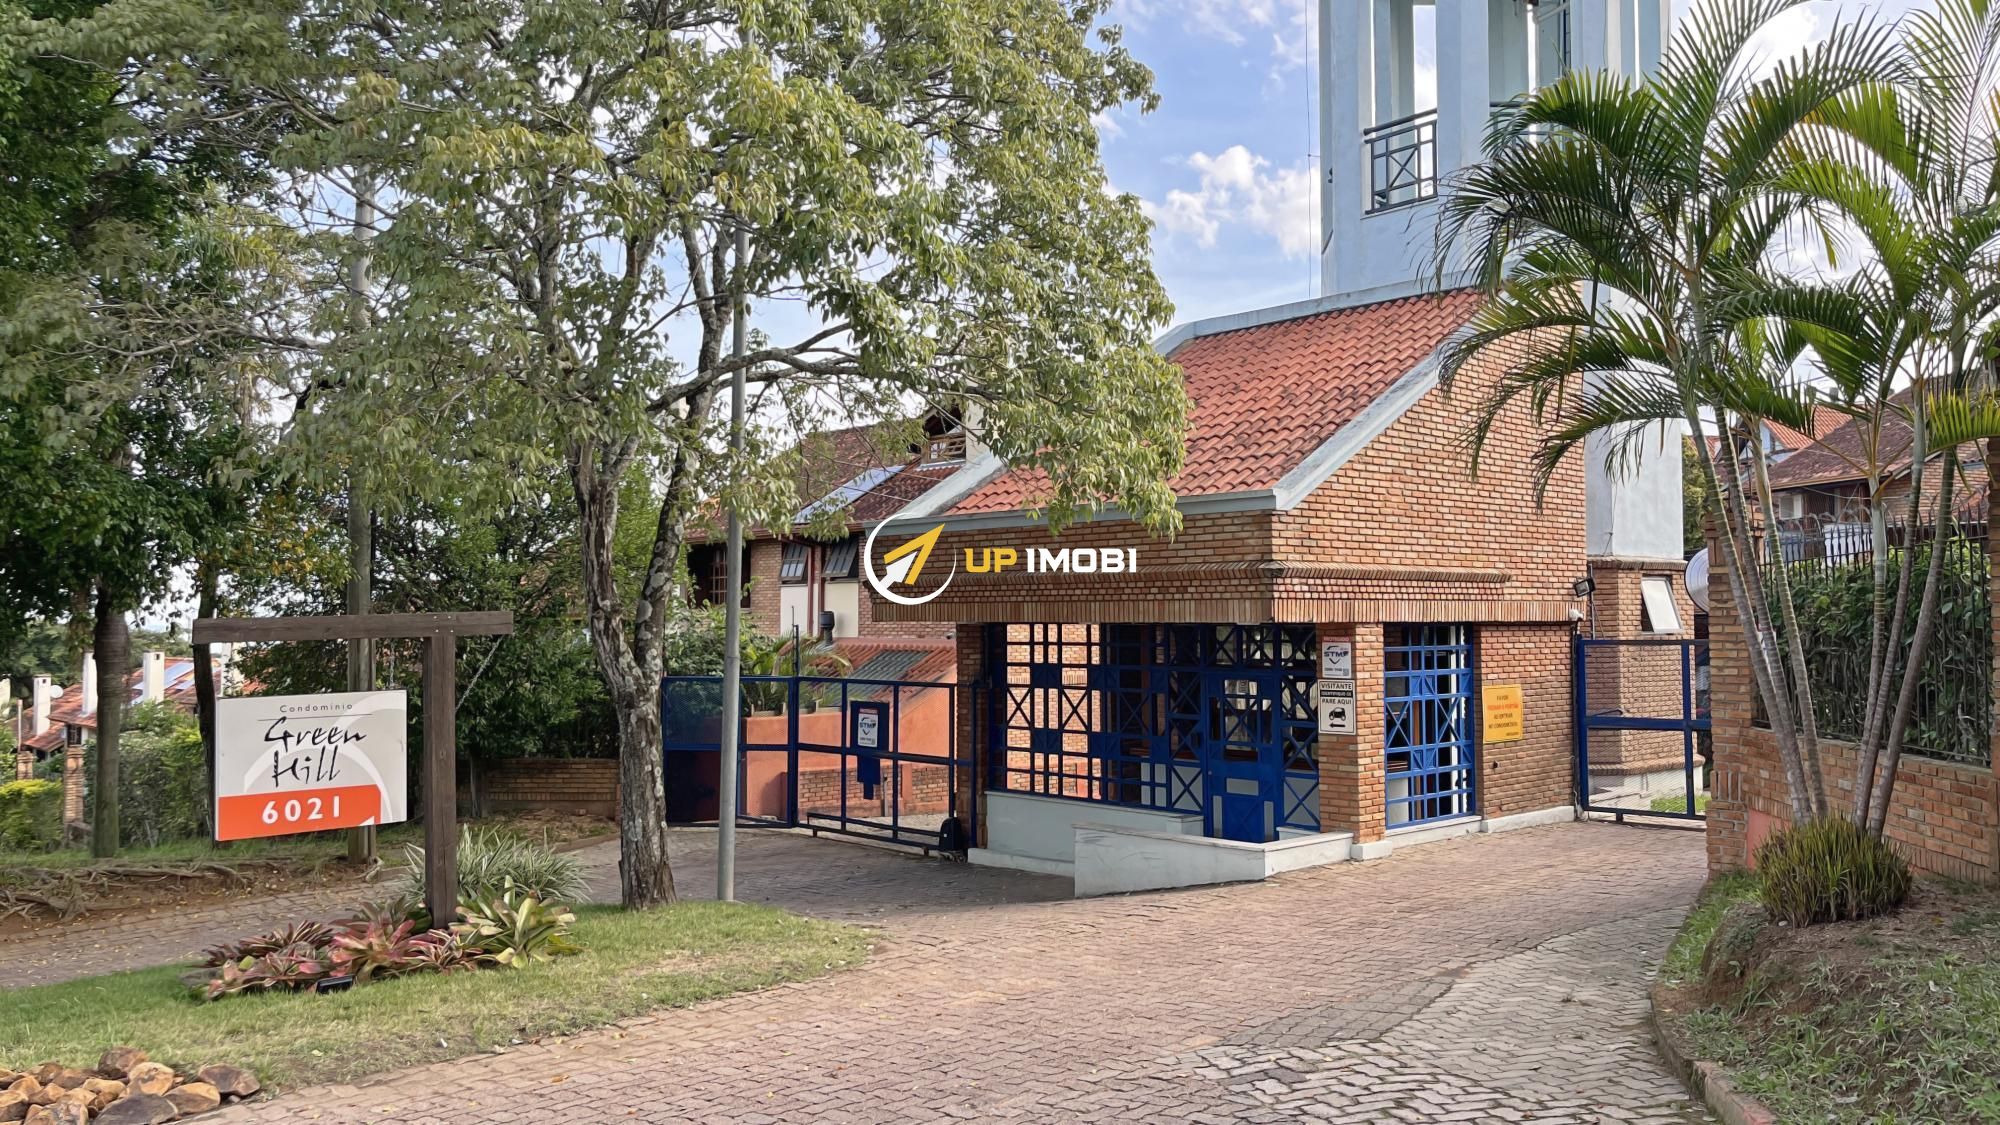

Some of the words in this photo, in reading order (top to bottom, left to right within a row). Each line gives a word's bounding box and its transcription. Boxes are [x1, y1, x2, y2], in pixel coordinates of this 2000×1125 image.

[264, 716, 368, 752] Green
[272, 745, 341, 788] Hill
[262, 795, 340, 824] 6021
